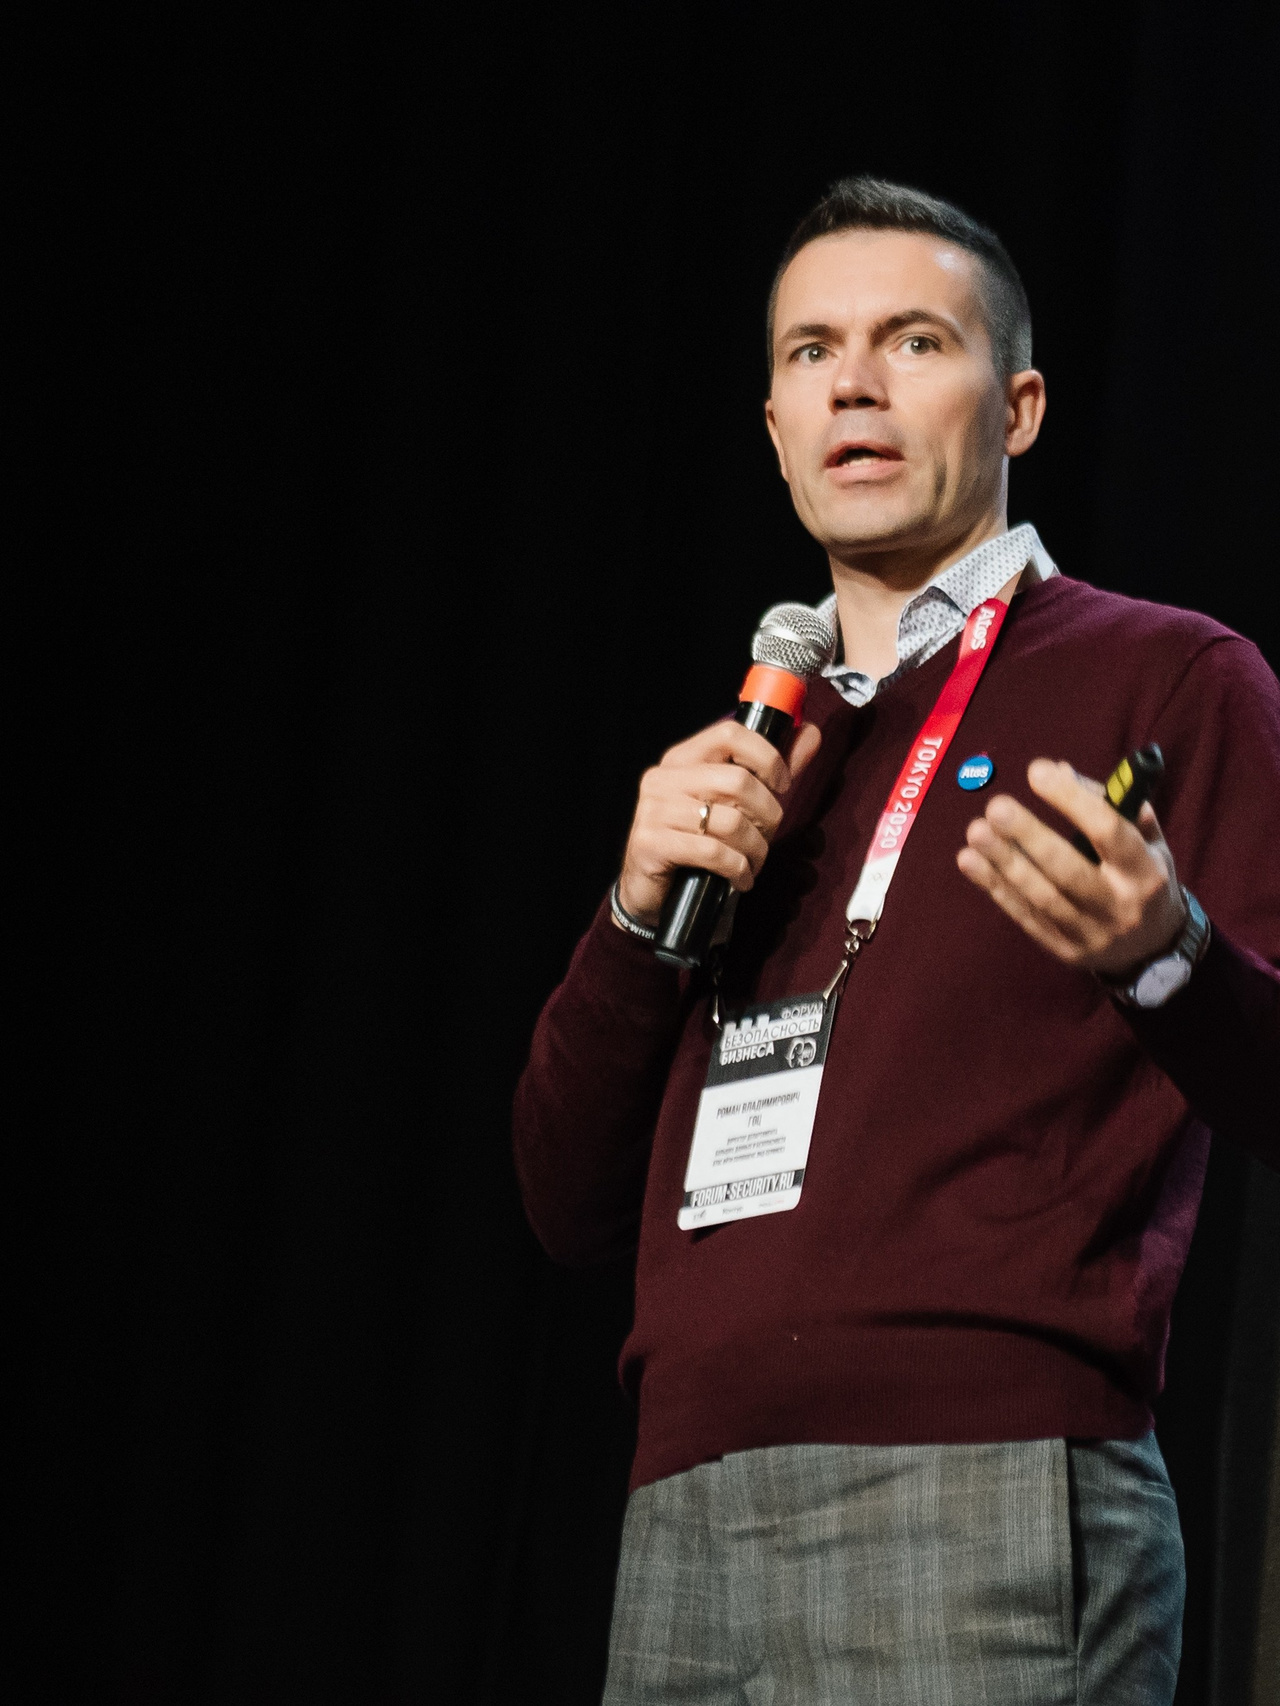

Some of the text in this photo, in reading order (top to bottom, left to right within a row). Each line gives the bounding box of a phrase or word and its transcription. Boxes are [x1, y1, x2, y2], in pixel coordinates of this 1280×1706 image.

[880, 736, 943, 849] TOKYO 2020
[780, 1001, 823, 1020] ФОРУМ
[724, 1017, 820, 1049] БЕЗОПАСНОСТЬ
[720, 1042, 775, 1066] БИЗНЕСА
[692, 1170, 796, 1208] FORUM-SECURITY.RU
